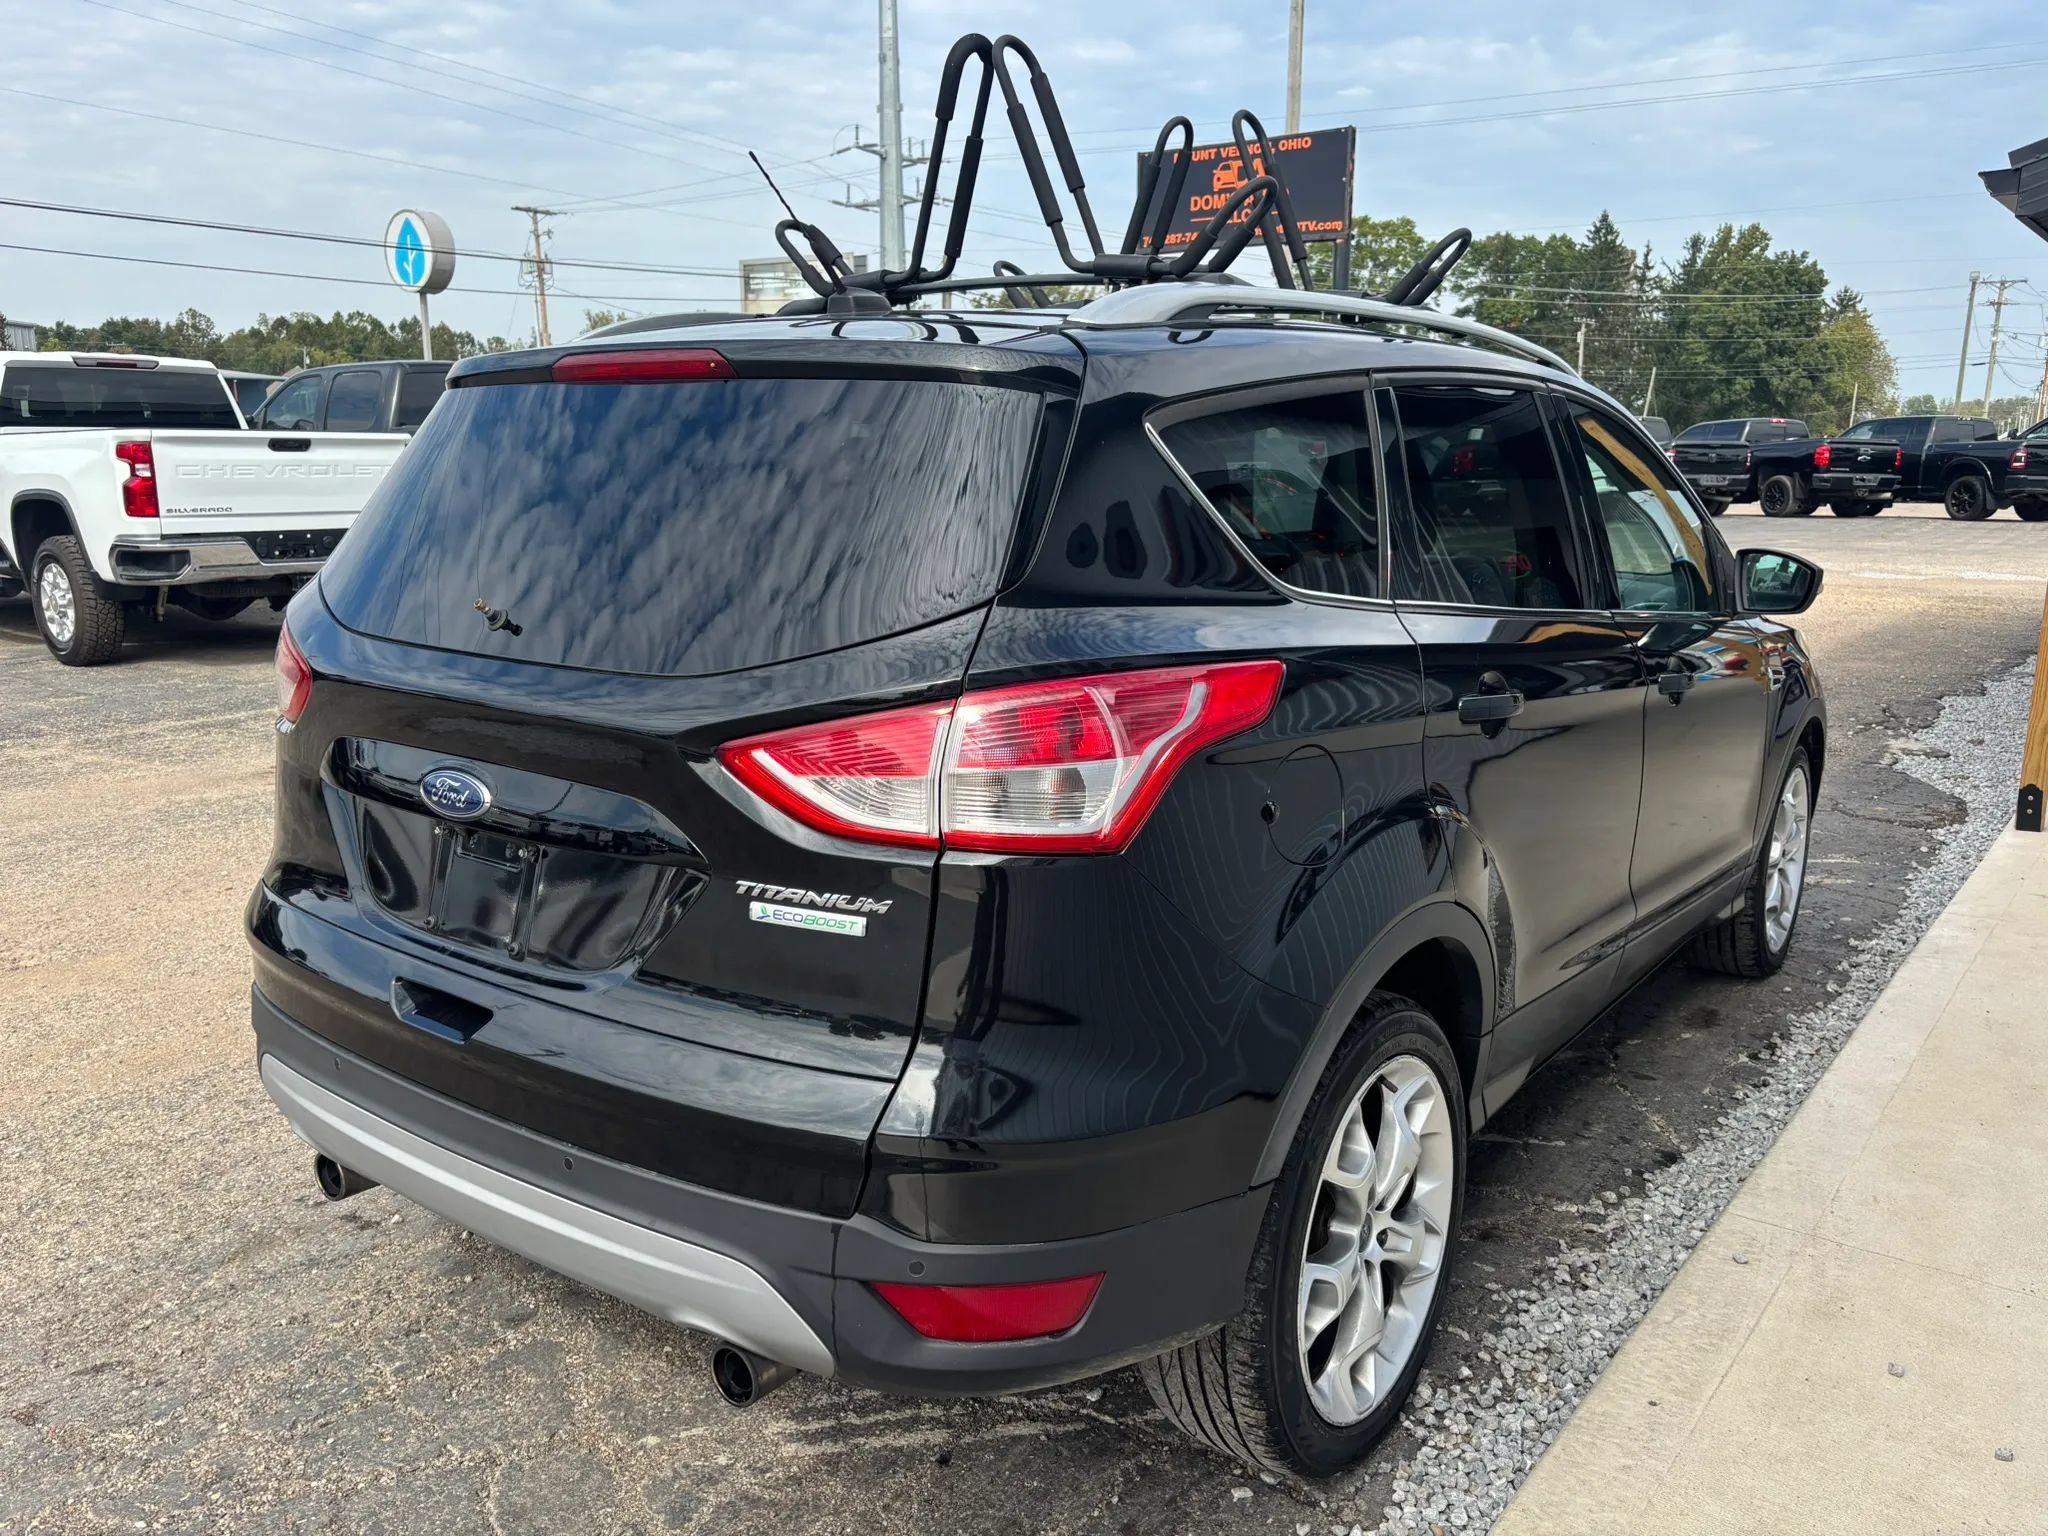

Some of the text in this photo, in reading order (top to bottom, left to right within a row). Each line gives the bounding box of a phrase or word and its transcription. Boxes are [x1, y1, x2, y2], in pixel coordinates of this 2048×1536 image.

[1279, 136, 1312, 151] OHIO
[165, 506, 233, 514] SILVERADO
[431, 777, 470, 808] Ford
[735, 880, 894, 915] TITANIUM
[772, 909, 859, 931] ECOBOOST
